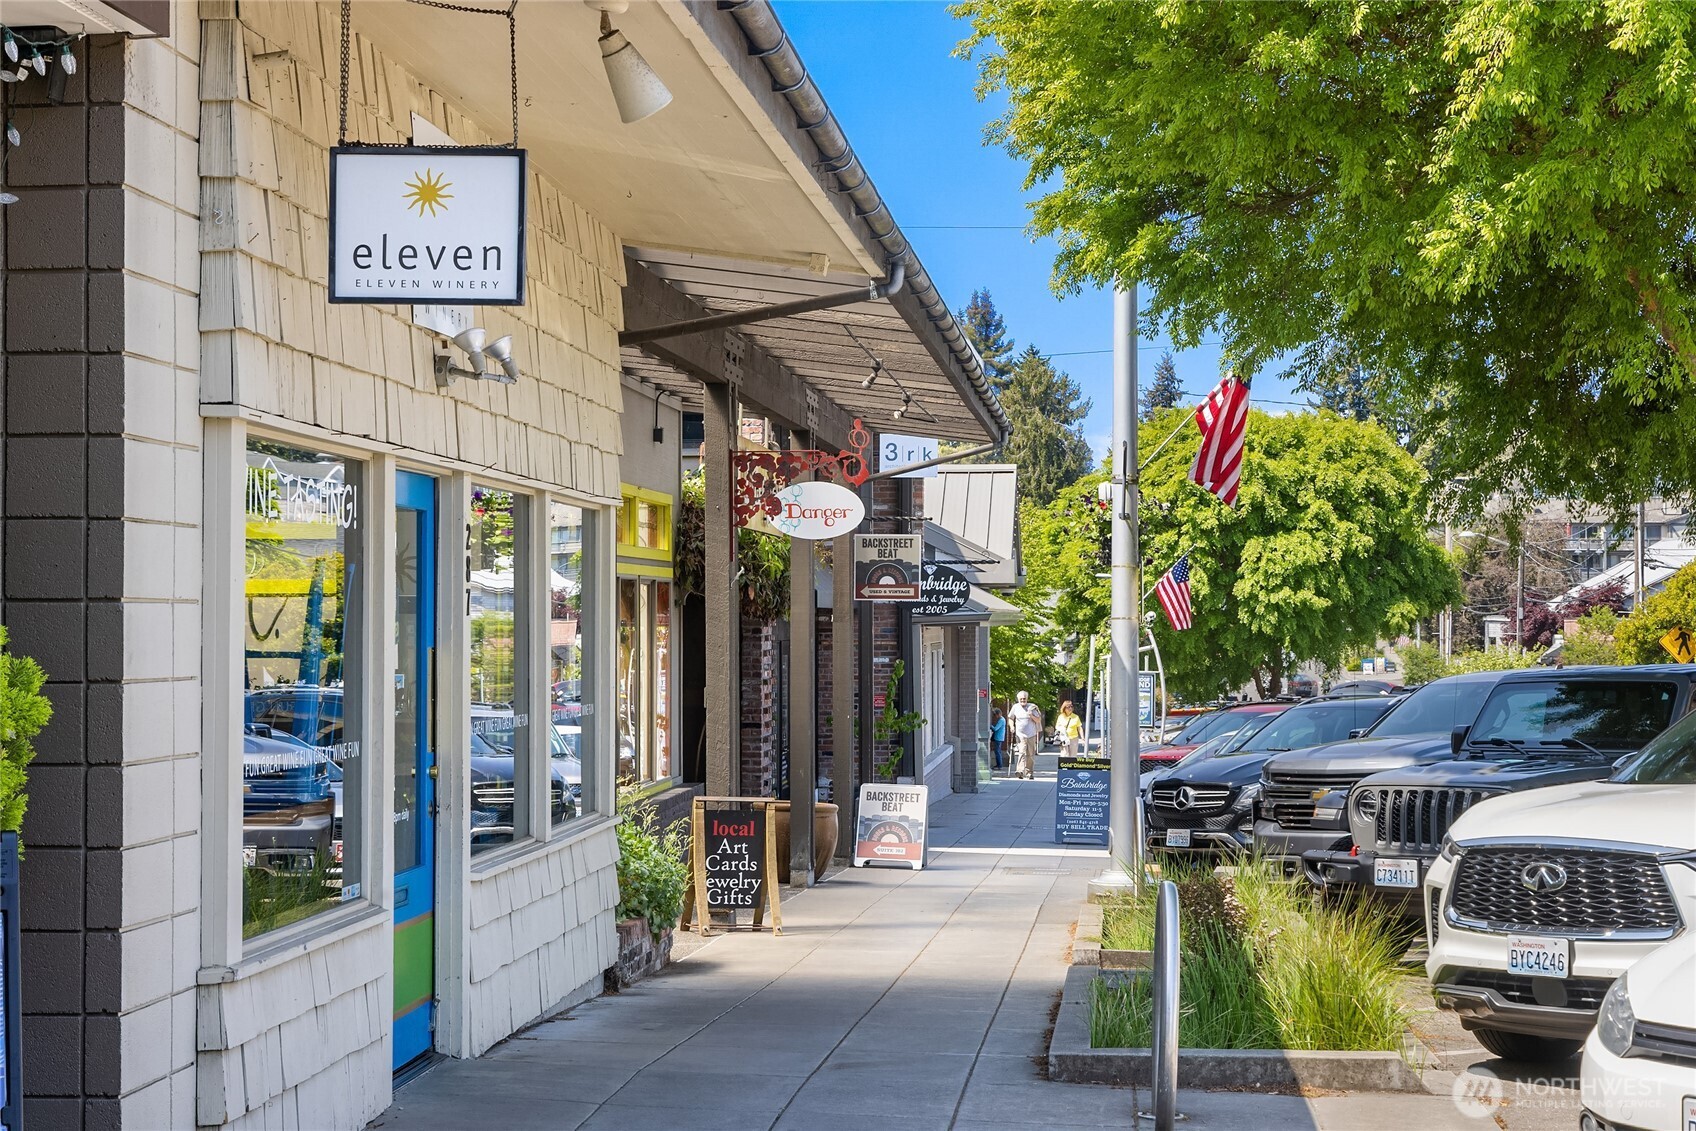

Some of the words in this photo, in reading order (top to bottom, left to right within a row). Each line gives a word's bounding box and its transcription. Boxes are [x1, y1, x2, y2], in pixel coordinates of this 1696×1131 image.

[352, 233, 502, 271] eleven
[355, 279, 420, 288] ELEVEN
[432, 280, 500, 289] WINERY
[284, 474, 357, 530] TASTING!
[785, 503, 853, 527] Danger
[862, 538, 914, 548] BACKSTREET
[877, 549, 898, 558] BEAT
[920, 575, 967, 595] nbridge
[938, 595, 965, 604] Jewelry
[925, 606, 948, 614] 2005
[333, 743, 347, 761] WINE
[348, 741, 360, 758] FUN
[1061, 777, 1107, 792] Bainbridge
[866, 791, 921, 803] BACKSTREET
[881, 802, 904, 812] BEAT
[713, 820, 755, 836] local
[717, 837, 748, 854] Art
[705, 854, 757, 871] Cards
[706, 872, 762, 894] ewelry
[707, 888, 752, 905] Gifts
[1512, 941, 1545, 949] WASHINGTON
[1511, 949, 1564, 971] BYC4246
